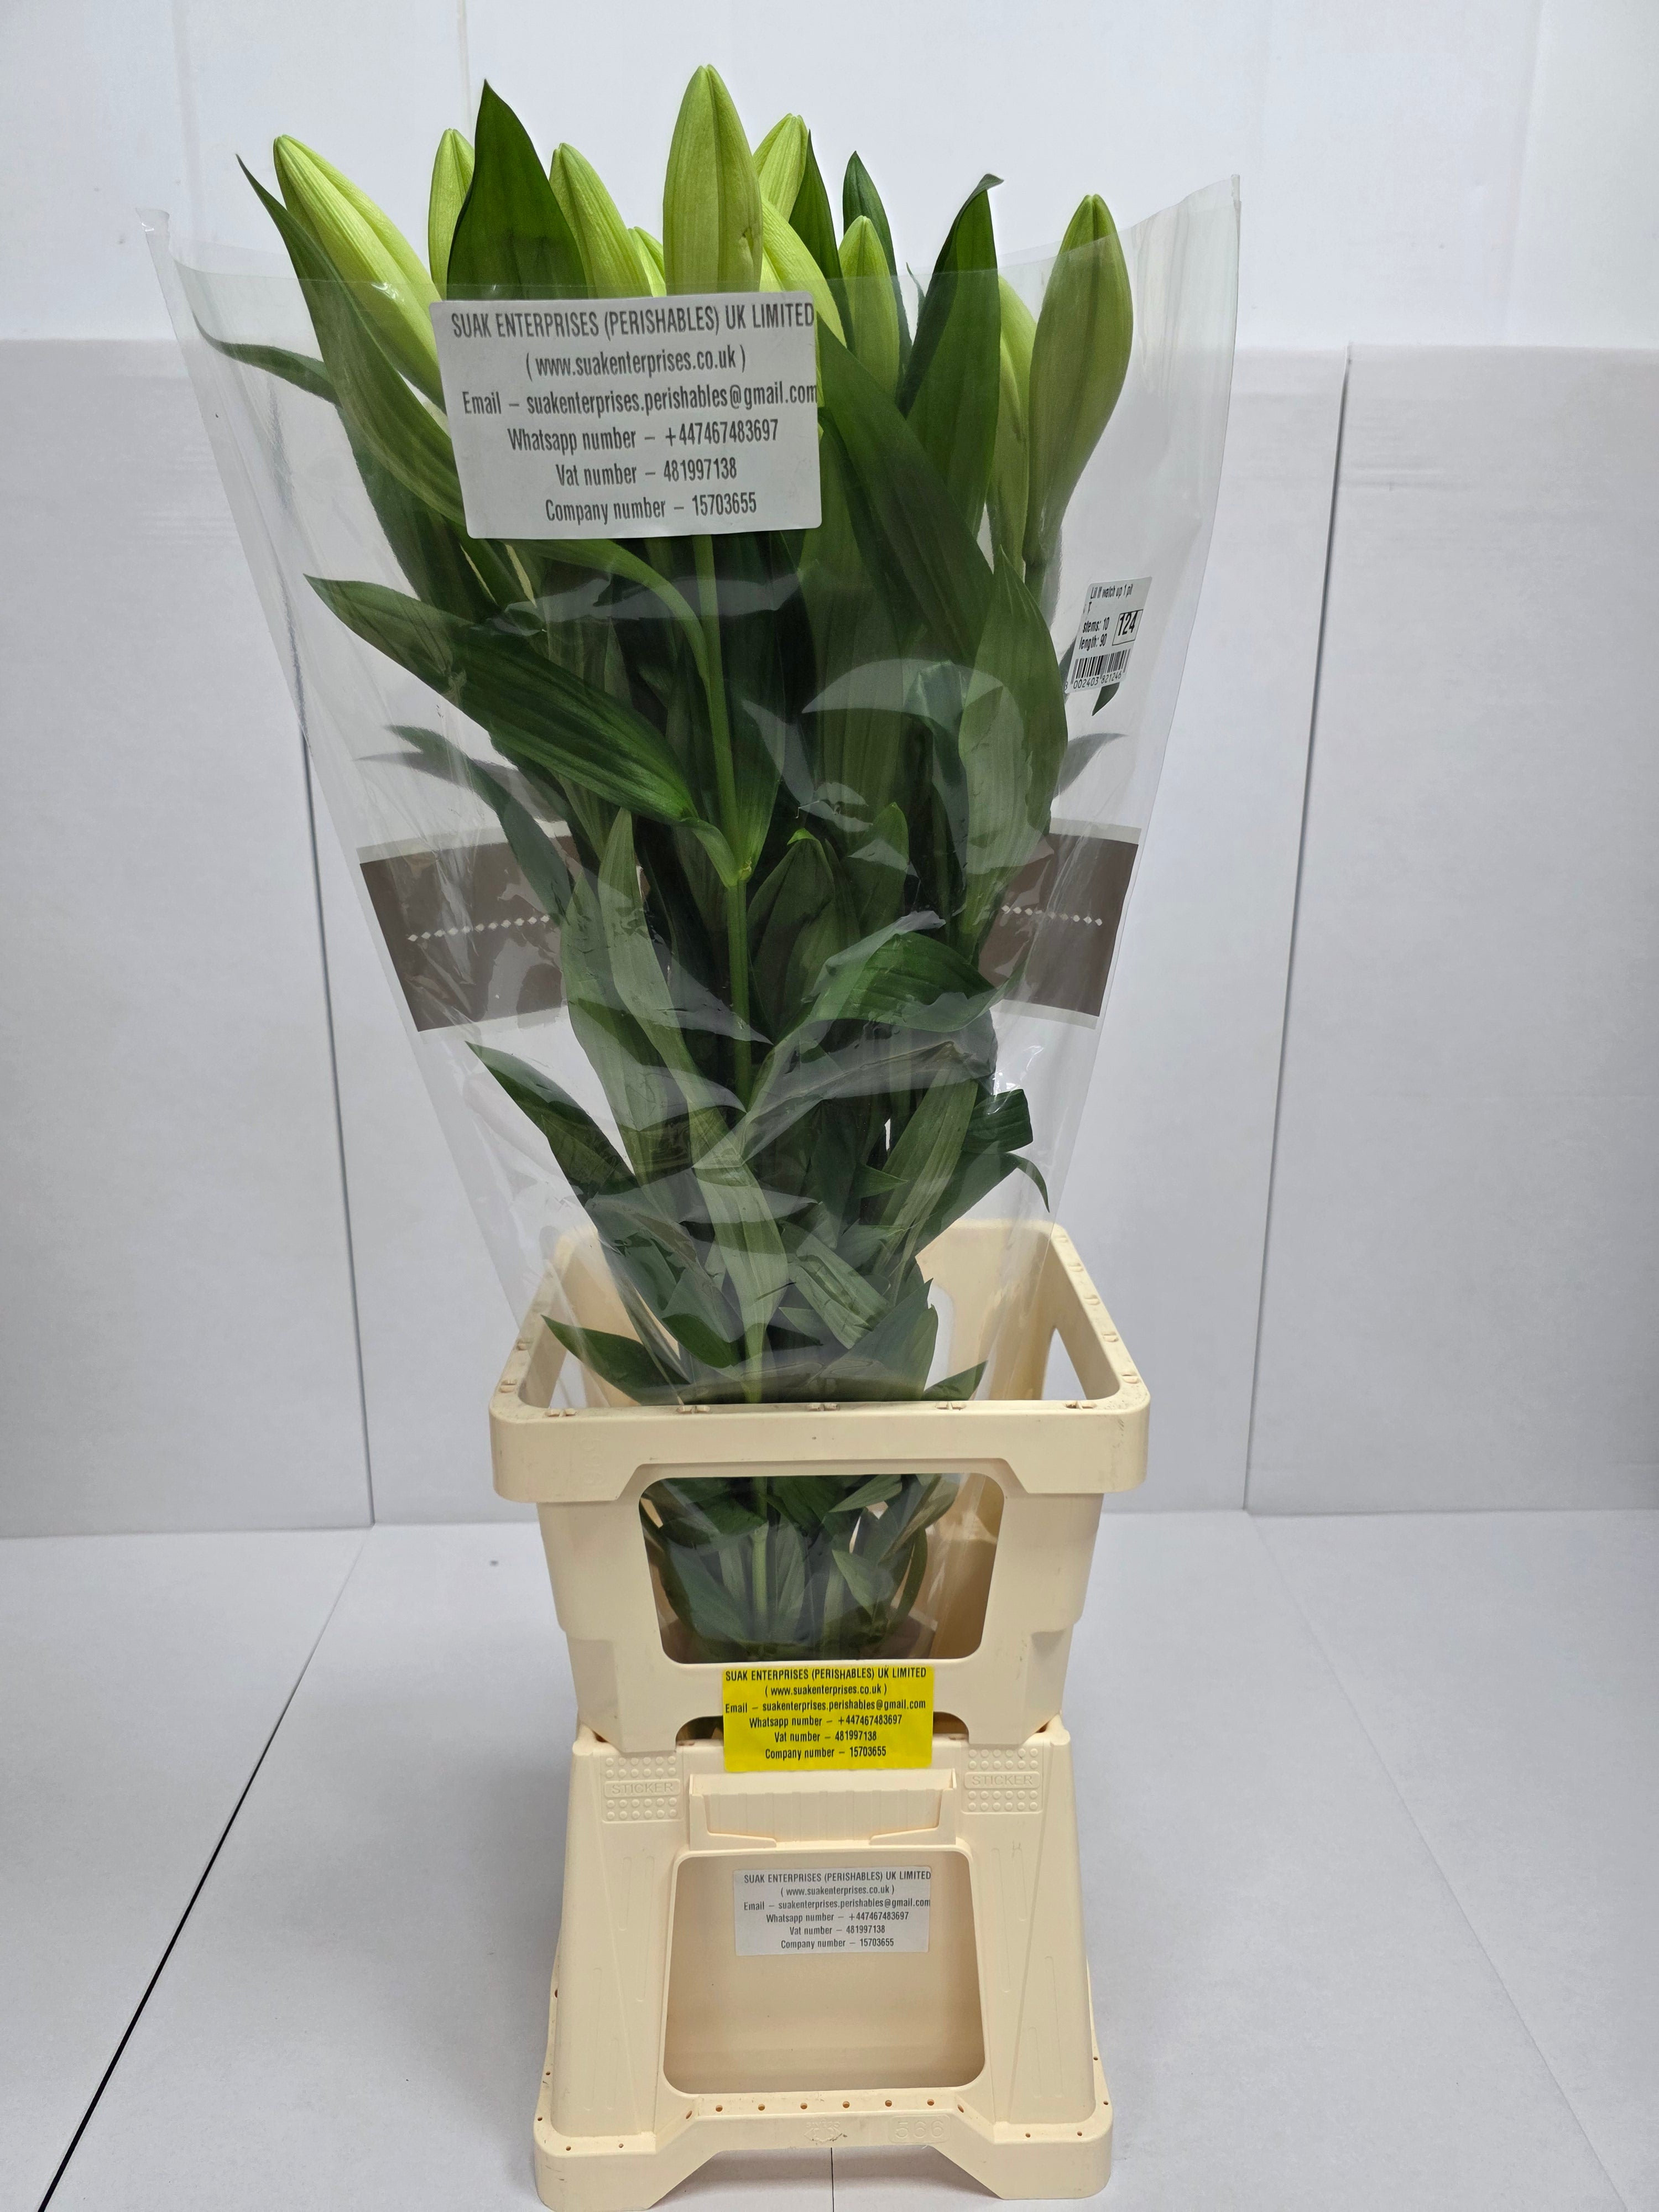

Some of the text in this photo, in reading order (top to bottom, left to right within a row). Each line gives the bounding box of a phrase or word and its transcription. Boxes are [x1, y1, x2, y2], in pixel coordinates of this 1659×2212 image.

[451, 302, 814, 341] SUAK ENTERPRISES (PERISHABLES) UK LIMITED
[535, 345, 735, 378] www.suakenterprises.co.uk
[462, 392, 501, 414] Email
[527, 380, 819, 418] suakenterprises.perishables@gmail.com
[507, 429, 577, 455] Whatsapp
[582, 427, 635, 450] number
[556, 465, 579, 486] Vat
[584, 463, 637, 486] number
[664, 457, 737, 481] 481997138
[546, 499, 608, 525] Company
[613, 497, 665, 519] number
[692, 492, 757, 515] 15703655
[1116, 587, 1123, 599] up
[1082, 617, 1110, 634] stems: 10
[1118, 610, 1138, 636] 124
[1079, 634, 1108, 651] length: 90
[1073, 677, 1099, 690] 002403
[1101, 672, 1121, 684] 821246
[726, 1667, 926, 1681] SUAK ENTERPRISES (PERISHABLES) UK LIMITED
[771, 1684, 881, 1696] www.suakenterprises.co.uk
[726, 1703, 747, 1713] Email
[763, 1699, 925, 1712] suakenterprises.perishables@gmail.com
[749, 1717, 788, 1728] Whatsapp
[792, 1715, 822, 1726] number
[775, 1732, 786, 1743] Vat
[790, 1731, 820, 1741] number
[835, 1730, 877, 1741] 481997138
[765, 1749, 801, 1761] Company
[805, 1747, 834, 1758] number
[850, 1746, 886, 1757] 15703655
[972, 1775, 1033, 1786] STICKER
[611, 1782, 673, 1795] STICKER
[744, 1871, 931, 1884] SUAK ENTERPRISES (PERISHABLES) UK LIMITED
[786, 1885, 889, 1896] www.suakenterprises.co.uk
[744, 1901, 764, 1910] Email
[779, 1898, 931, 1910] suakenterprises.perishables@gmail.com
[766, 1914, 802, 1923] Whatsapp
[806, 1913, 834, 1921] number
[790, 1927, 801, 1935] Vat
[804, 1926, 832, 1934] number
[846, 1925, 885, 1934] 481997138
[781, 1940, 815, 1950] Company
[818, 1939, 846, 1947] number
[860, 1938, 894, 1947] 15703655
[895, 2120, 944, 2139] 566
